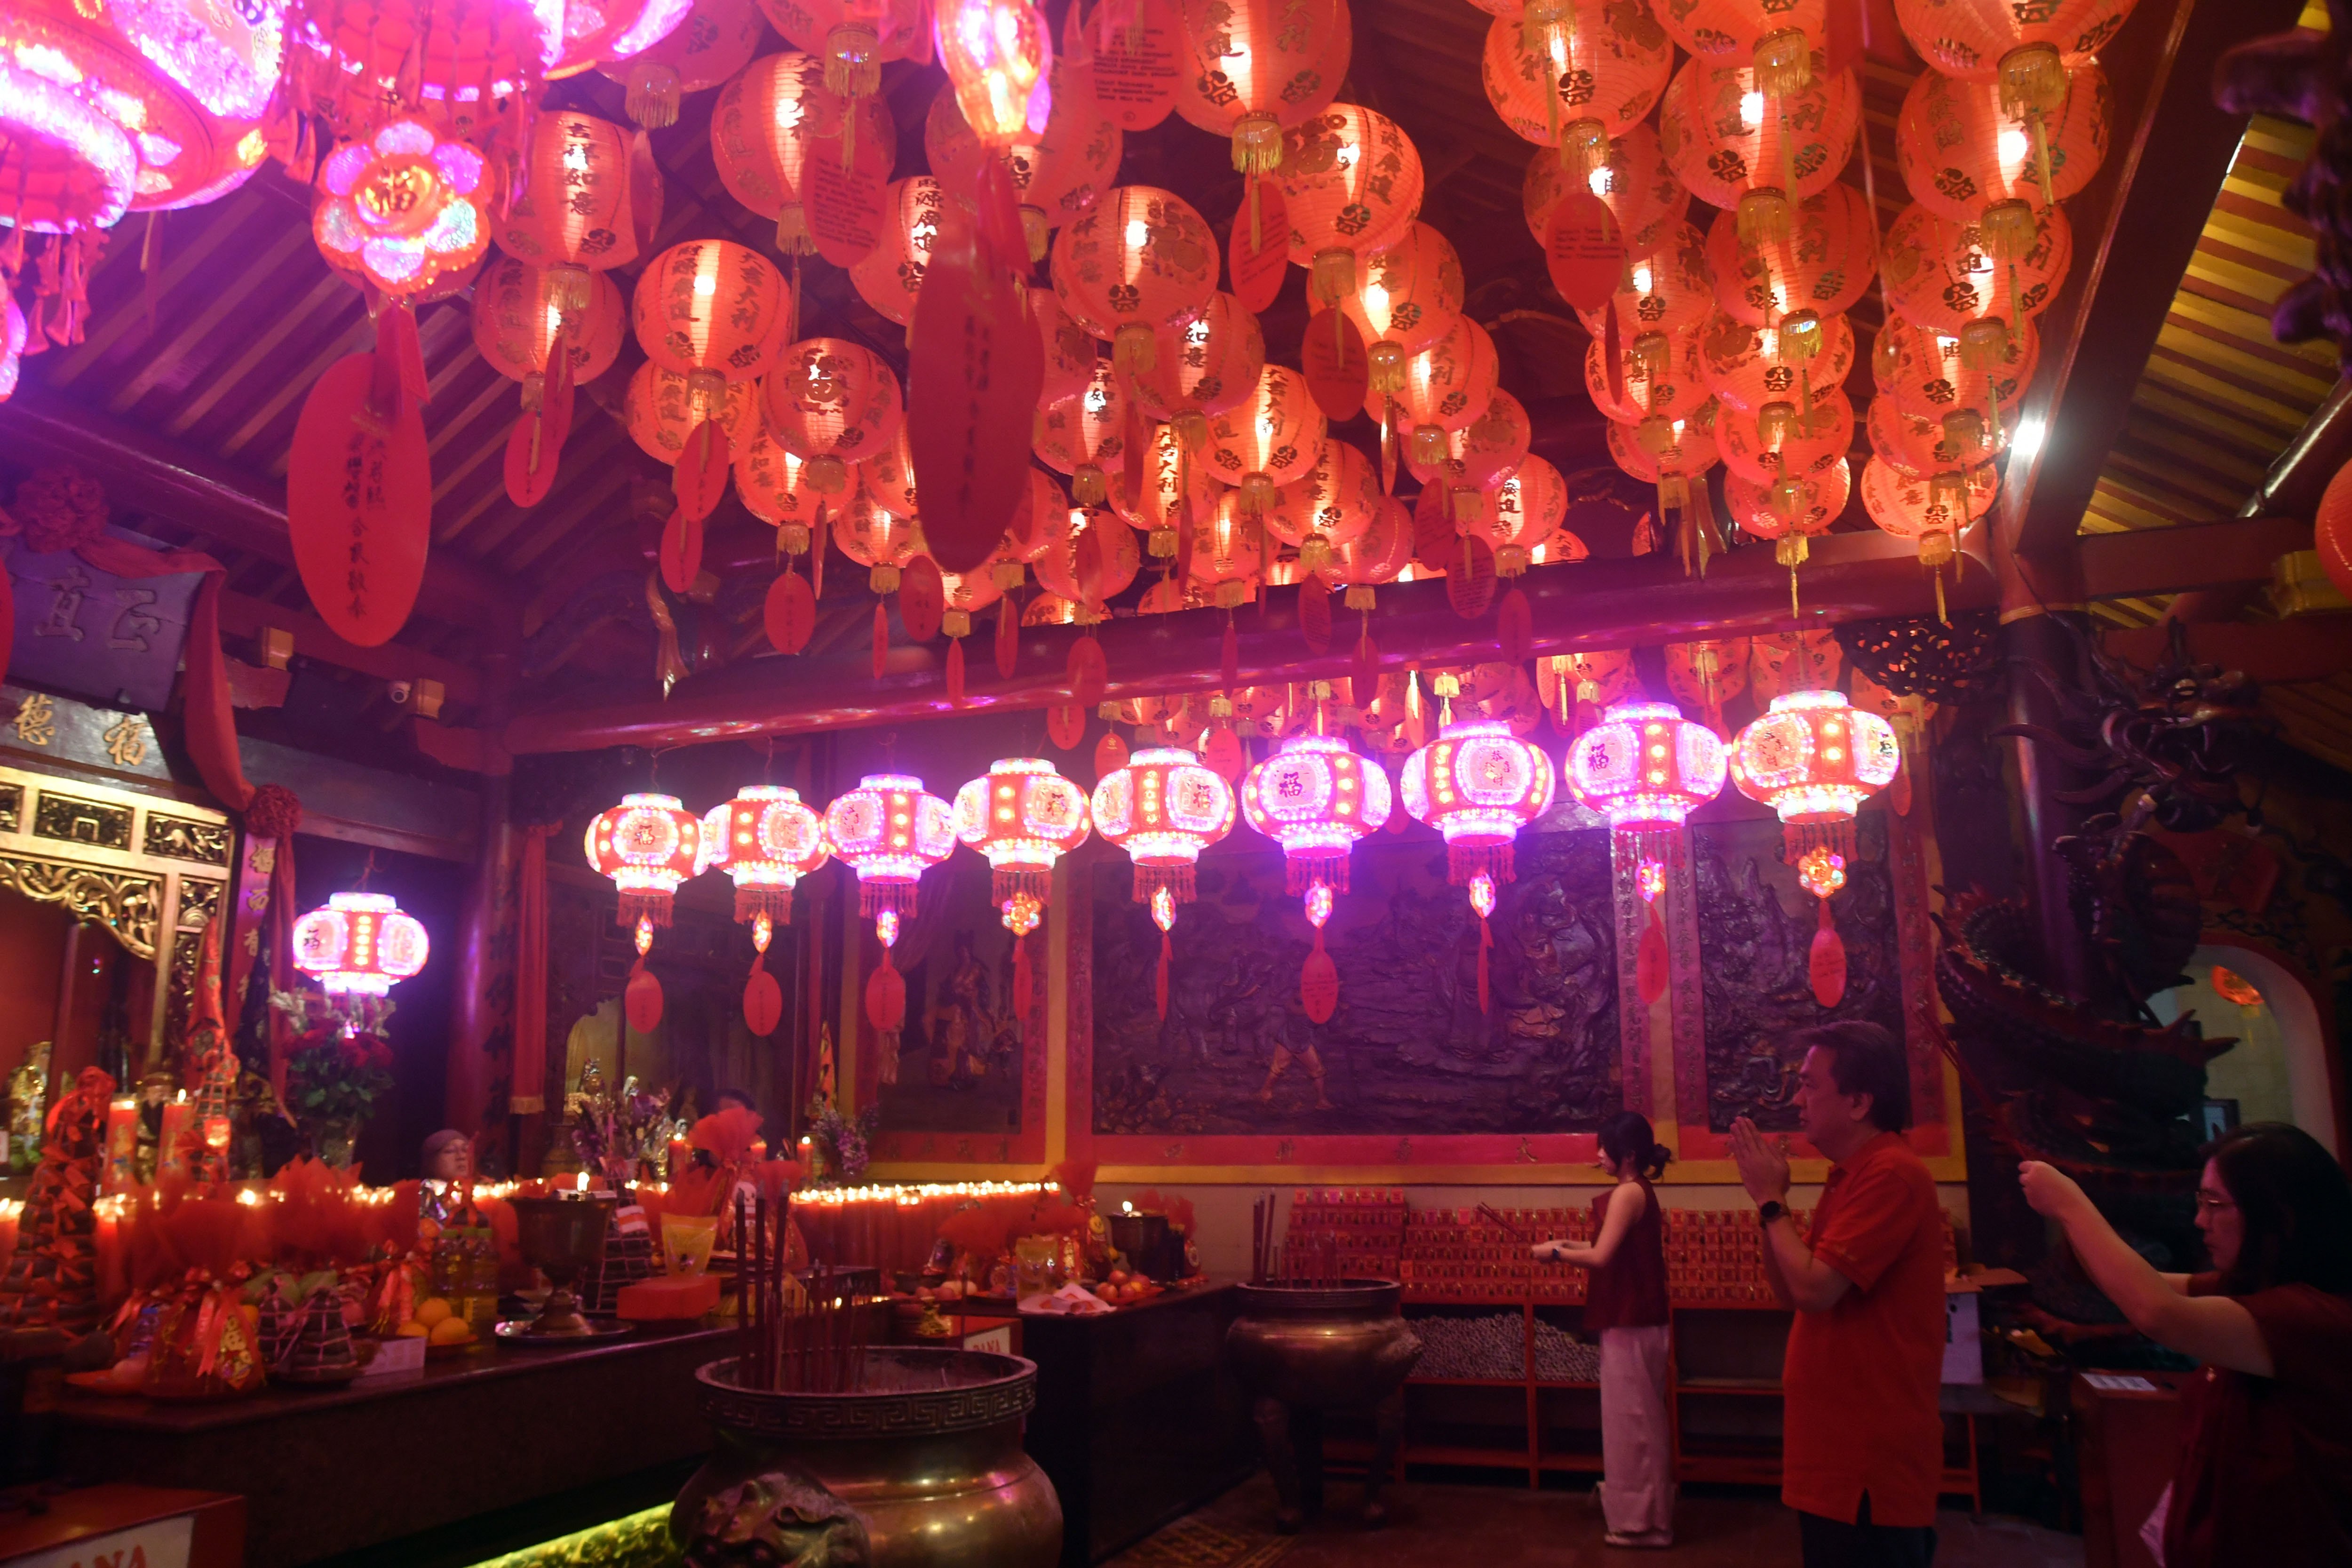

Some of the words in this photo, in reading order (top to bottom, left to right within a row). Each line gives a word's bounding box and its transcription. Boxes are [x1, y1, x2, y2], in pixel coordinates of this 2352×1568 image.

[731, 251, 765, 332] 大吉大利
[1261, 368, 1289, 437] 大吉大利
[1154, 430, 1184, 493] 大吉大利
[1279, 772, 1303, 798] 福
